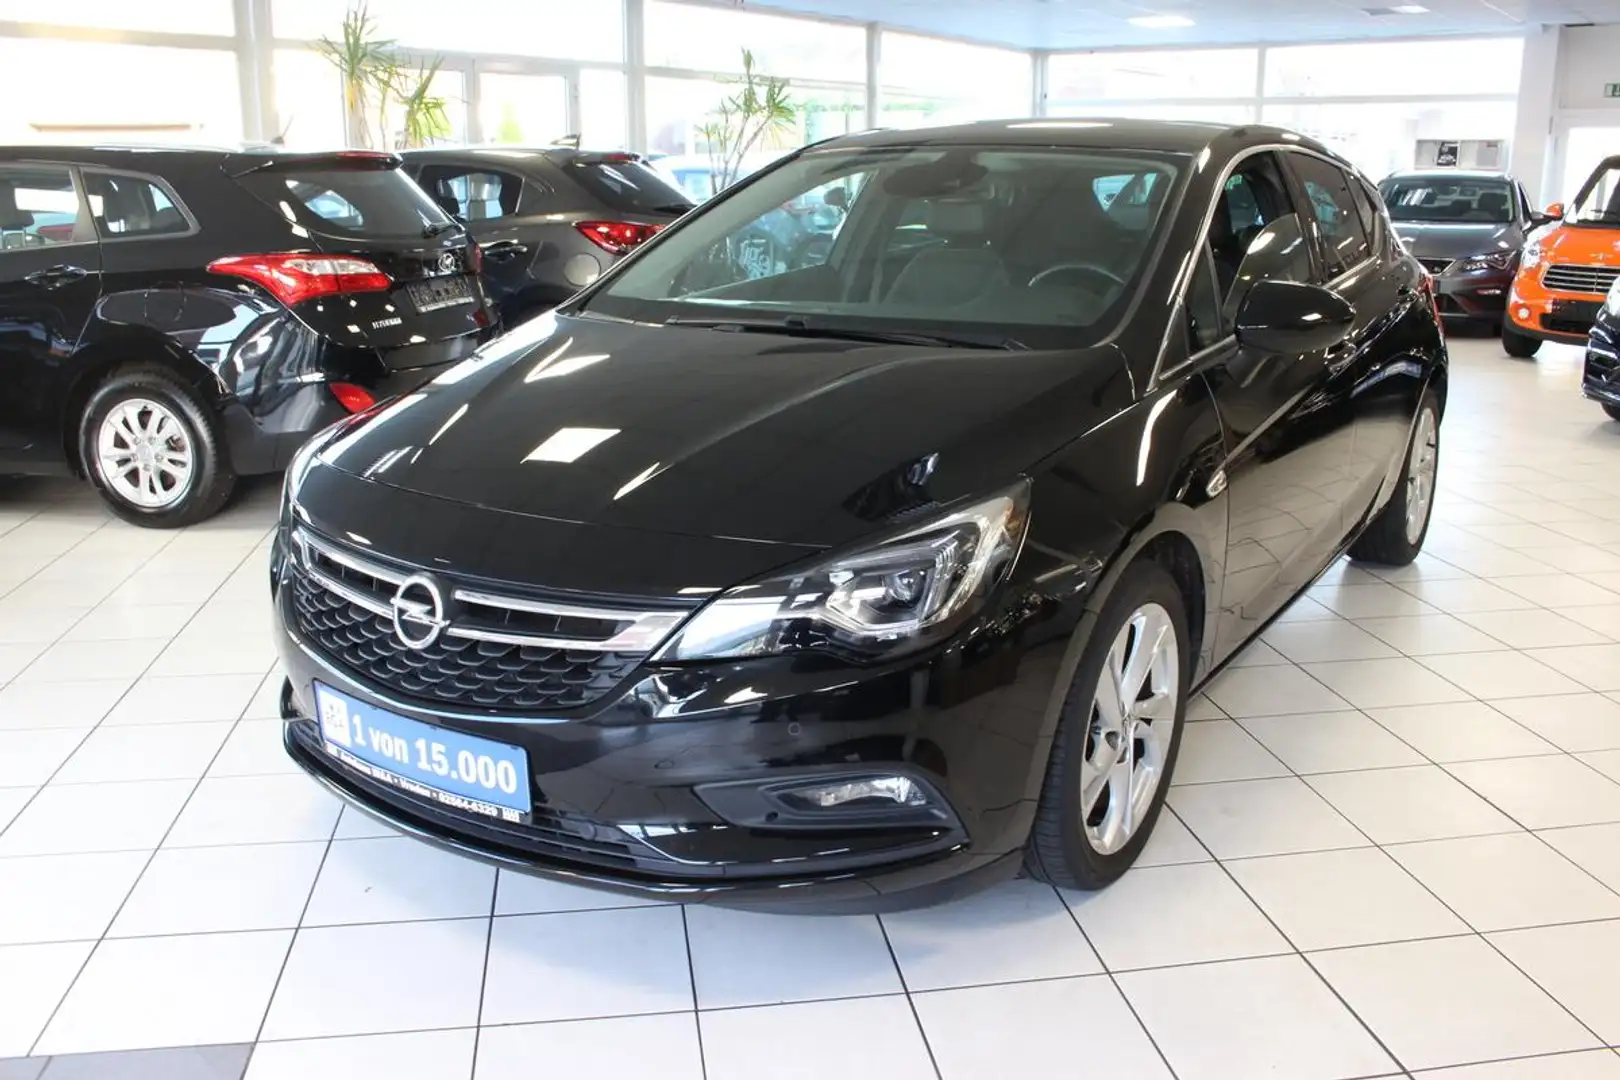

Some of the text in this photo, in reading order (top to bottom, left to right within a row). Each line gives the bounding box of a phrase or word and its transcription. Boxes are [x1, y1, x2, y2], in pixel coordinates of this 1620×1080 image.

[353, 713, 367, 747] 1
[368, 726, 410, 764] von
[415, 738, 517, 794] 15.000
